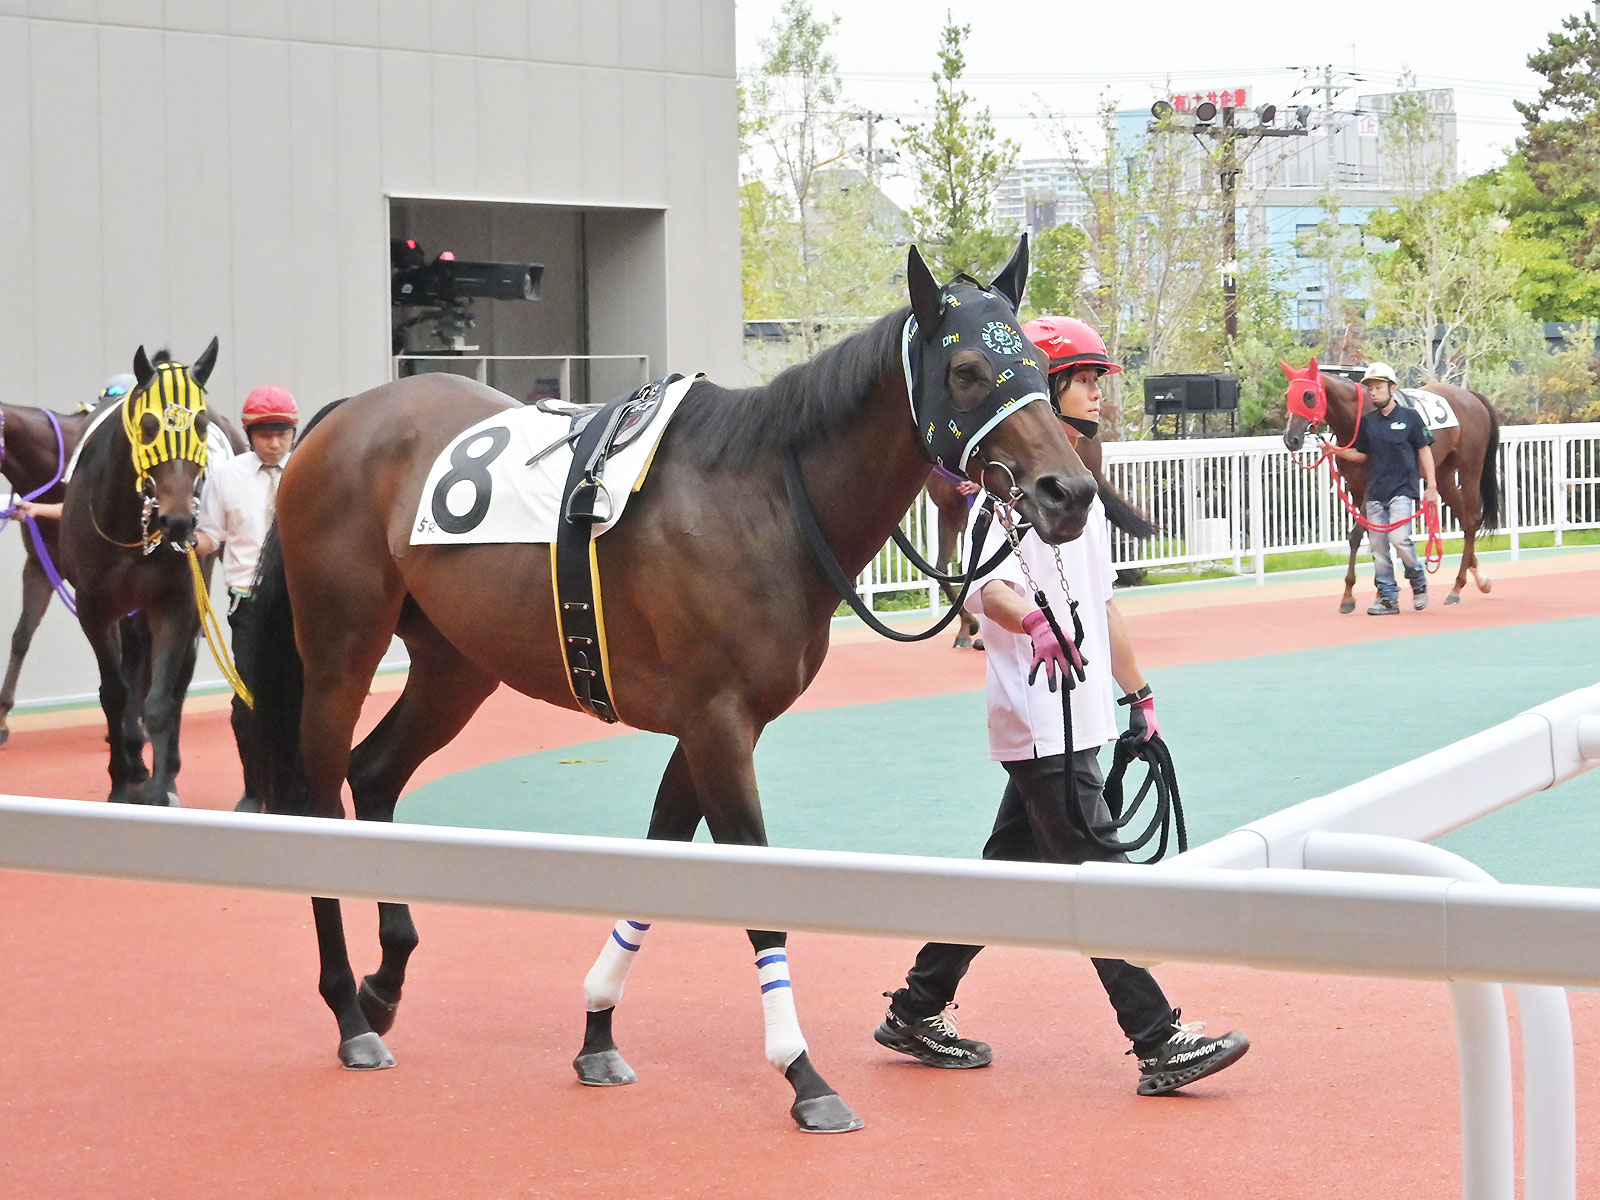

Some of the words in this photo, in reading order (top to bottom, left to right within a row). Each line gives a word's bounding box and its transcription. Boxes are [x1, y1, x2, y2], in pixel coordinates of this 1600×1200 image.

[942, 332, 960, 348] Oh!
[431, 425, 511, 534] 8
[417, 516, 436, 533] 5R
